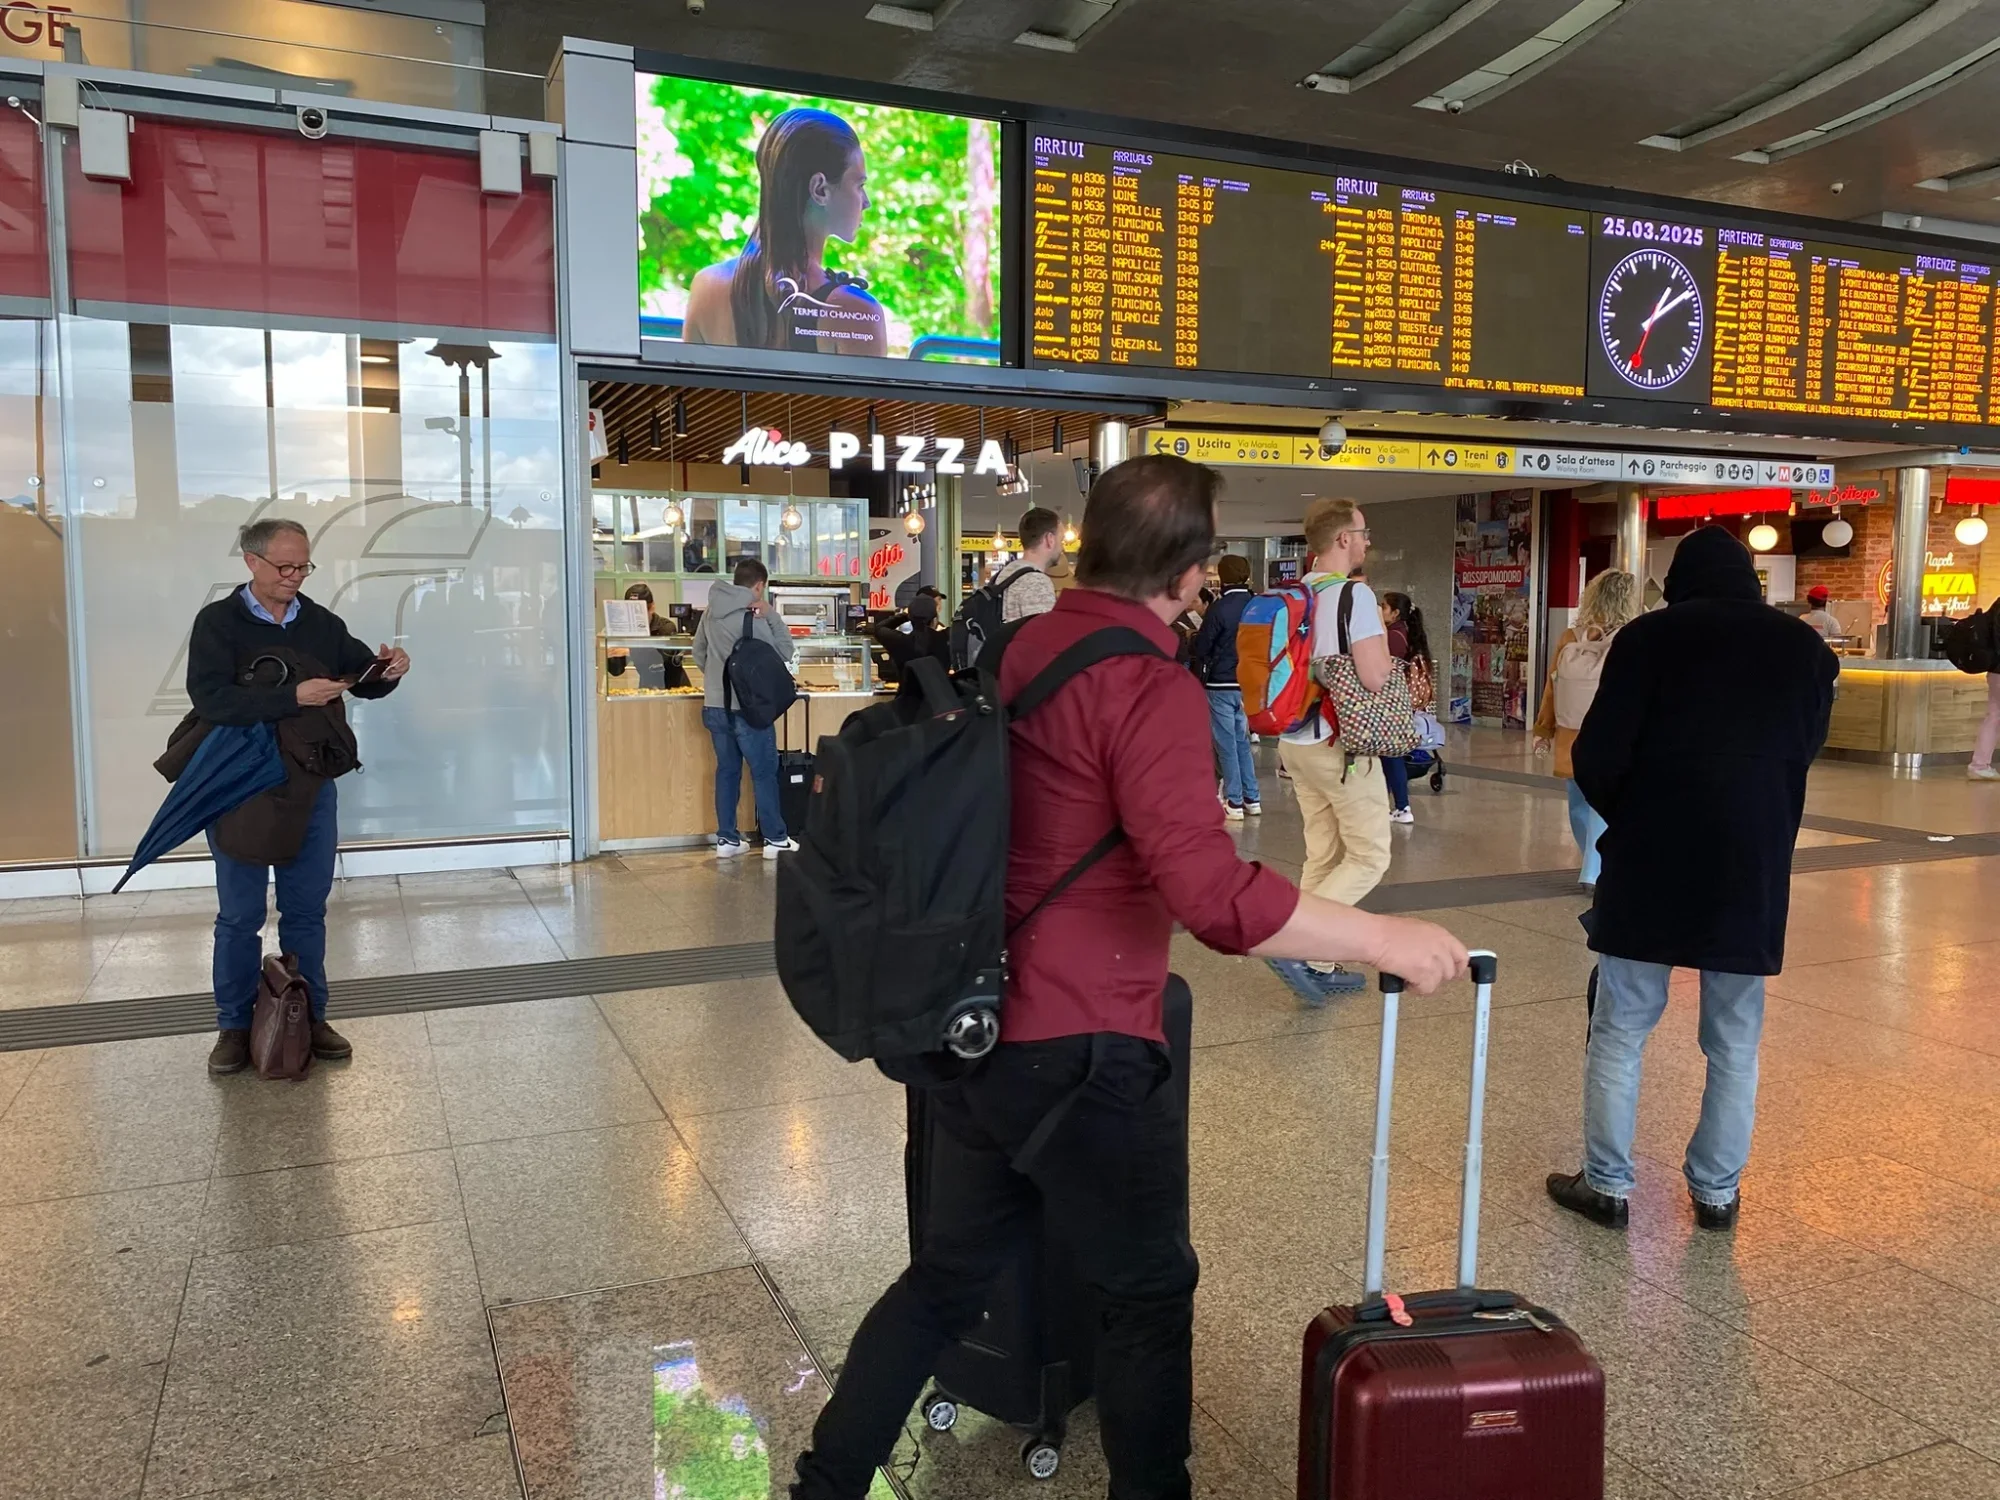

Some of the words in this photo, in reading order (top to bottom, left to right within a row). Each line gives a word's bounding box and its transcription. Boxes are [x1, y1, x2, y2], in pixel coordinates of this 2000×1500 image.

[1035, 136, 1084, 158] ARRIVI
[1113, 151, 1154, 166] ARRIVALS
[1084, 172, 1106, 184] 8306
[1113, 176, 1138, 189] LECCE
[1178, 185, 1200, 196] 12:55
[1336, 177, 1378, 197] ARRIVI
[1402, 189, 1435, 202] ARRIVALS
[1084, 186, 1106, 198] 8907
[1113, 190, 1138, 203] UDINE
[1178, 198, 1199, 210] 13:05
[1084, 200, 1106, 211] 9636
[1113, 203, 1142, 216] NAPOLI
[1178, 211, 1199, 223] 13:05
[1084, 213, 1106, 225] 4577
[1177, 224, 1198, 236] 13:10
[1603, 217, 1703, 246] 25.03.2025
[1084, 227, 1110, 238] 20240
[1113, 230, 1149, 244] NETTUNO
[1177, 238, 1199, 249] 13:18
[1718, 228, 1764, 246] PARTENZE
[1770, 238, 1804, 250] DEPARTURES
[1084, 241, 1106, 252] 12541
[1177, 251, 1198, 262] 13:18
[1084, 254, 1105, 265] 9422
[1112, 257, 1141, 270] NAPOLI
[1177, 264, 1198, 275] 13:20
[1916, 256, 1956, 272] PARTENZE
[1084, 268, 1108, 279] 12736
[1177, 277, 1198, 288] 13:24
[1083, 282, 1104, 292] 9923
[1112, 284, 1141, 296] TORINO
[1176, 290, 1198, 301] 13:24
[1083, 295, 1102, 306] 4617
[1176, 304, 1198, 314] 13:25
[793, 307, 818, 317] TERME
[830, 310, 880, 322] CHIANCIANO
[1083, 309, 1104, 319] 9977
[1112, 311, 1140, 323] MILANO
[1176, 317, 1198, 327] 13:25
[795, 327, 830, 337] Benessere
[831, 330, 850, 339] senza
[852, 332, 873, 341] tempo
[1083, 323, 1102, 333] 8134
[1176, 330, 1197, 340] 13:30
[1083, 336, 1100, 346] 9411
[1111, 338, 1146, 350] VENEZIA
[1176, 343, 1197, 354] 13:30
[1083, 350, 1098, 360] 550
[1176, 356, 1196, 367] 13:34
[721, 427, 811, 466] Alice
[829, 431, 1008, 475] PIZZA
[1197, 438, 1230, 448] Uscita
[1340, 444, 1371, 454] Uscita
[1464, 450, 1488, 460] Treni
[1556, 454, 1576, 464] Sala
[1579, 455, 1615, 466] d'attesa
[1660, 460, 1707, 473] Parcheggio
[1779, 468, 1789, 480] M
[1825, 485, 1880, 506] Bottega
[1462, 570, 1522, 584] ROSSOPOMODORO
